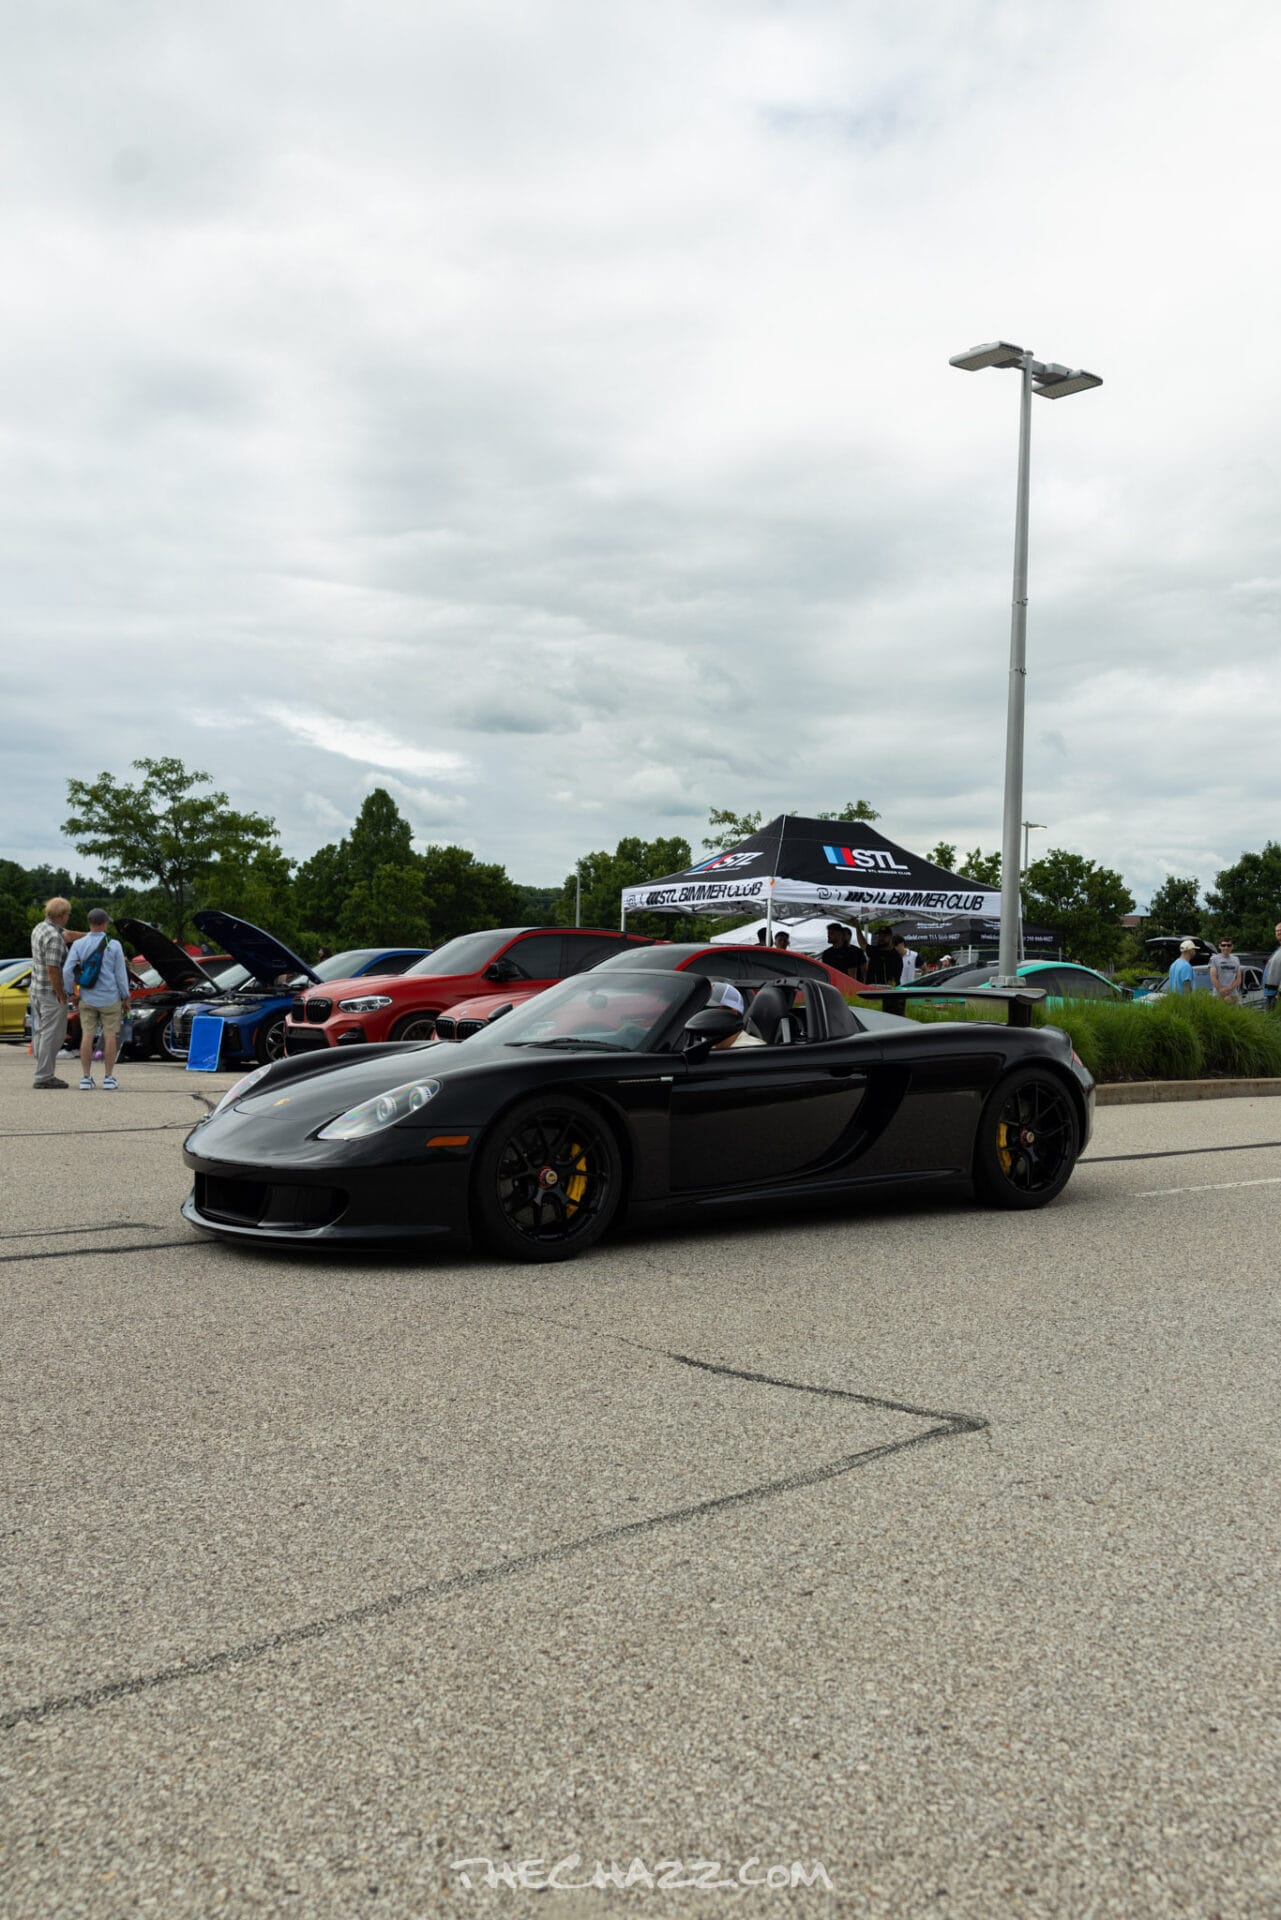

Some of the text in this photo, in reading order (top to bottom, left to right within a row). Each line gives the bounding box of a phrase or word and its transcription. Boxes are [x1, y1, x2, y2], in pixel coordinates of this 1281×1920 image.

[852, 849, 908, 870] STL
[679, 883, 727, 902] BIMMER
[726, 881, 763, 898] CLUB
[888, 892, 948, 909] BIMMER
[946, 894, 984, 911] CLUB
